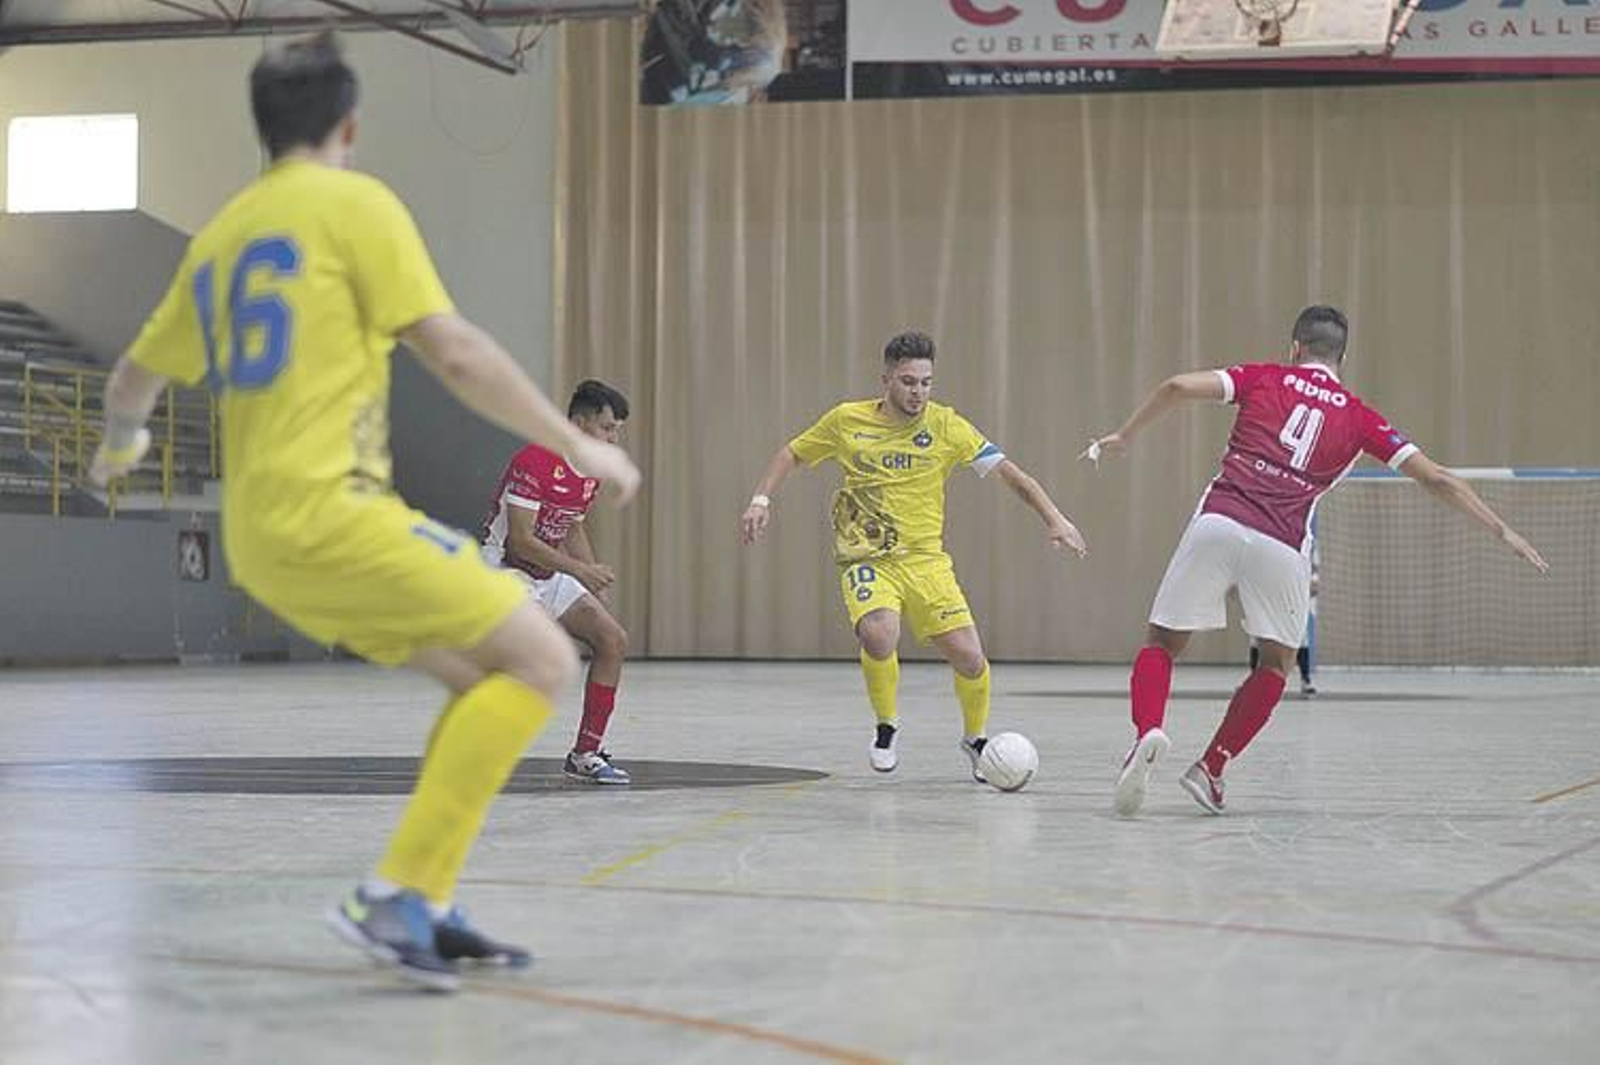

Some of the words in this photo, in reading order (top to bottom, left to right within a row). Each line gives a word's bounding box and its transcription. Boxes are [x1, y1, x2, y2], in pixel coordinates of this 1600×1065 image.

[947, 68, 1117, 86] www.cumegal.es
[193, 237, 299, 396] 16
[1283, 374, 1347, 407] PEDRO
[1279, 403, 1325, 471] 4
[848, 565, 875, 589] 10
